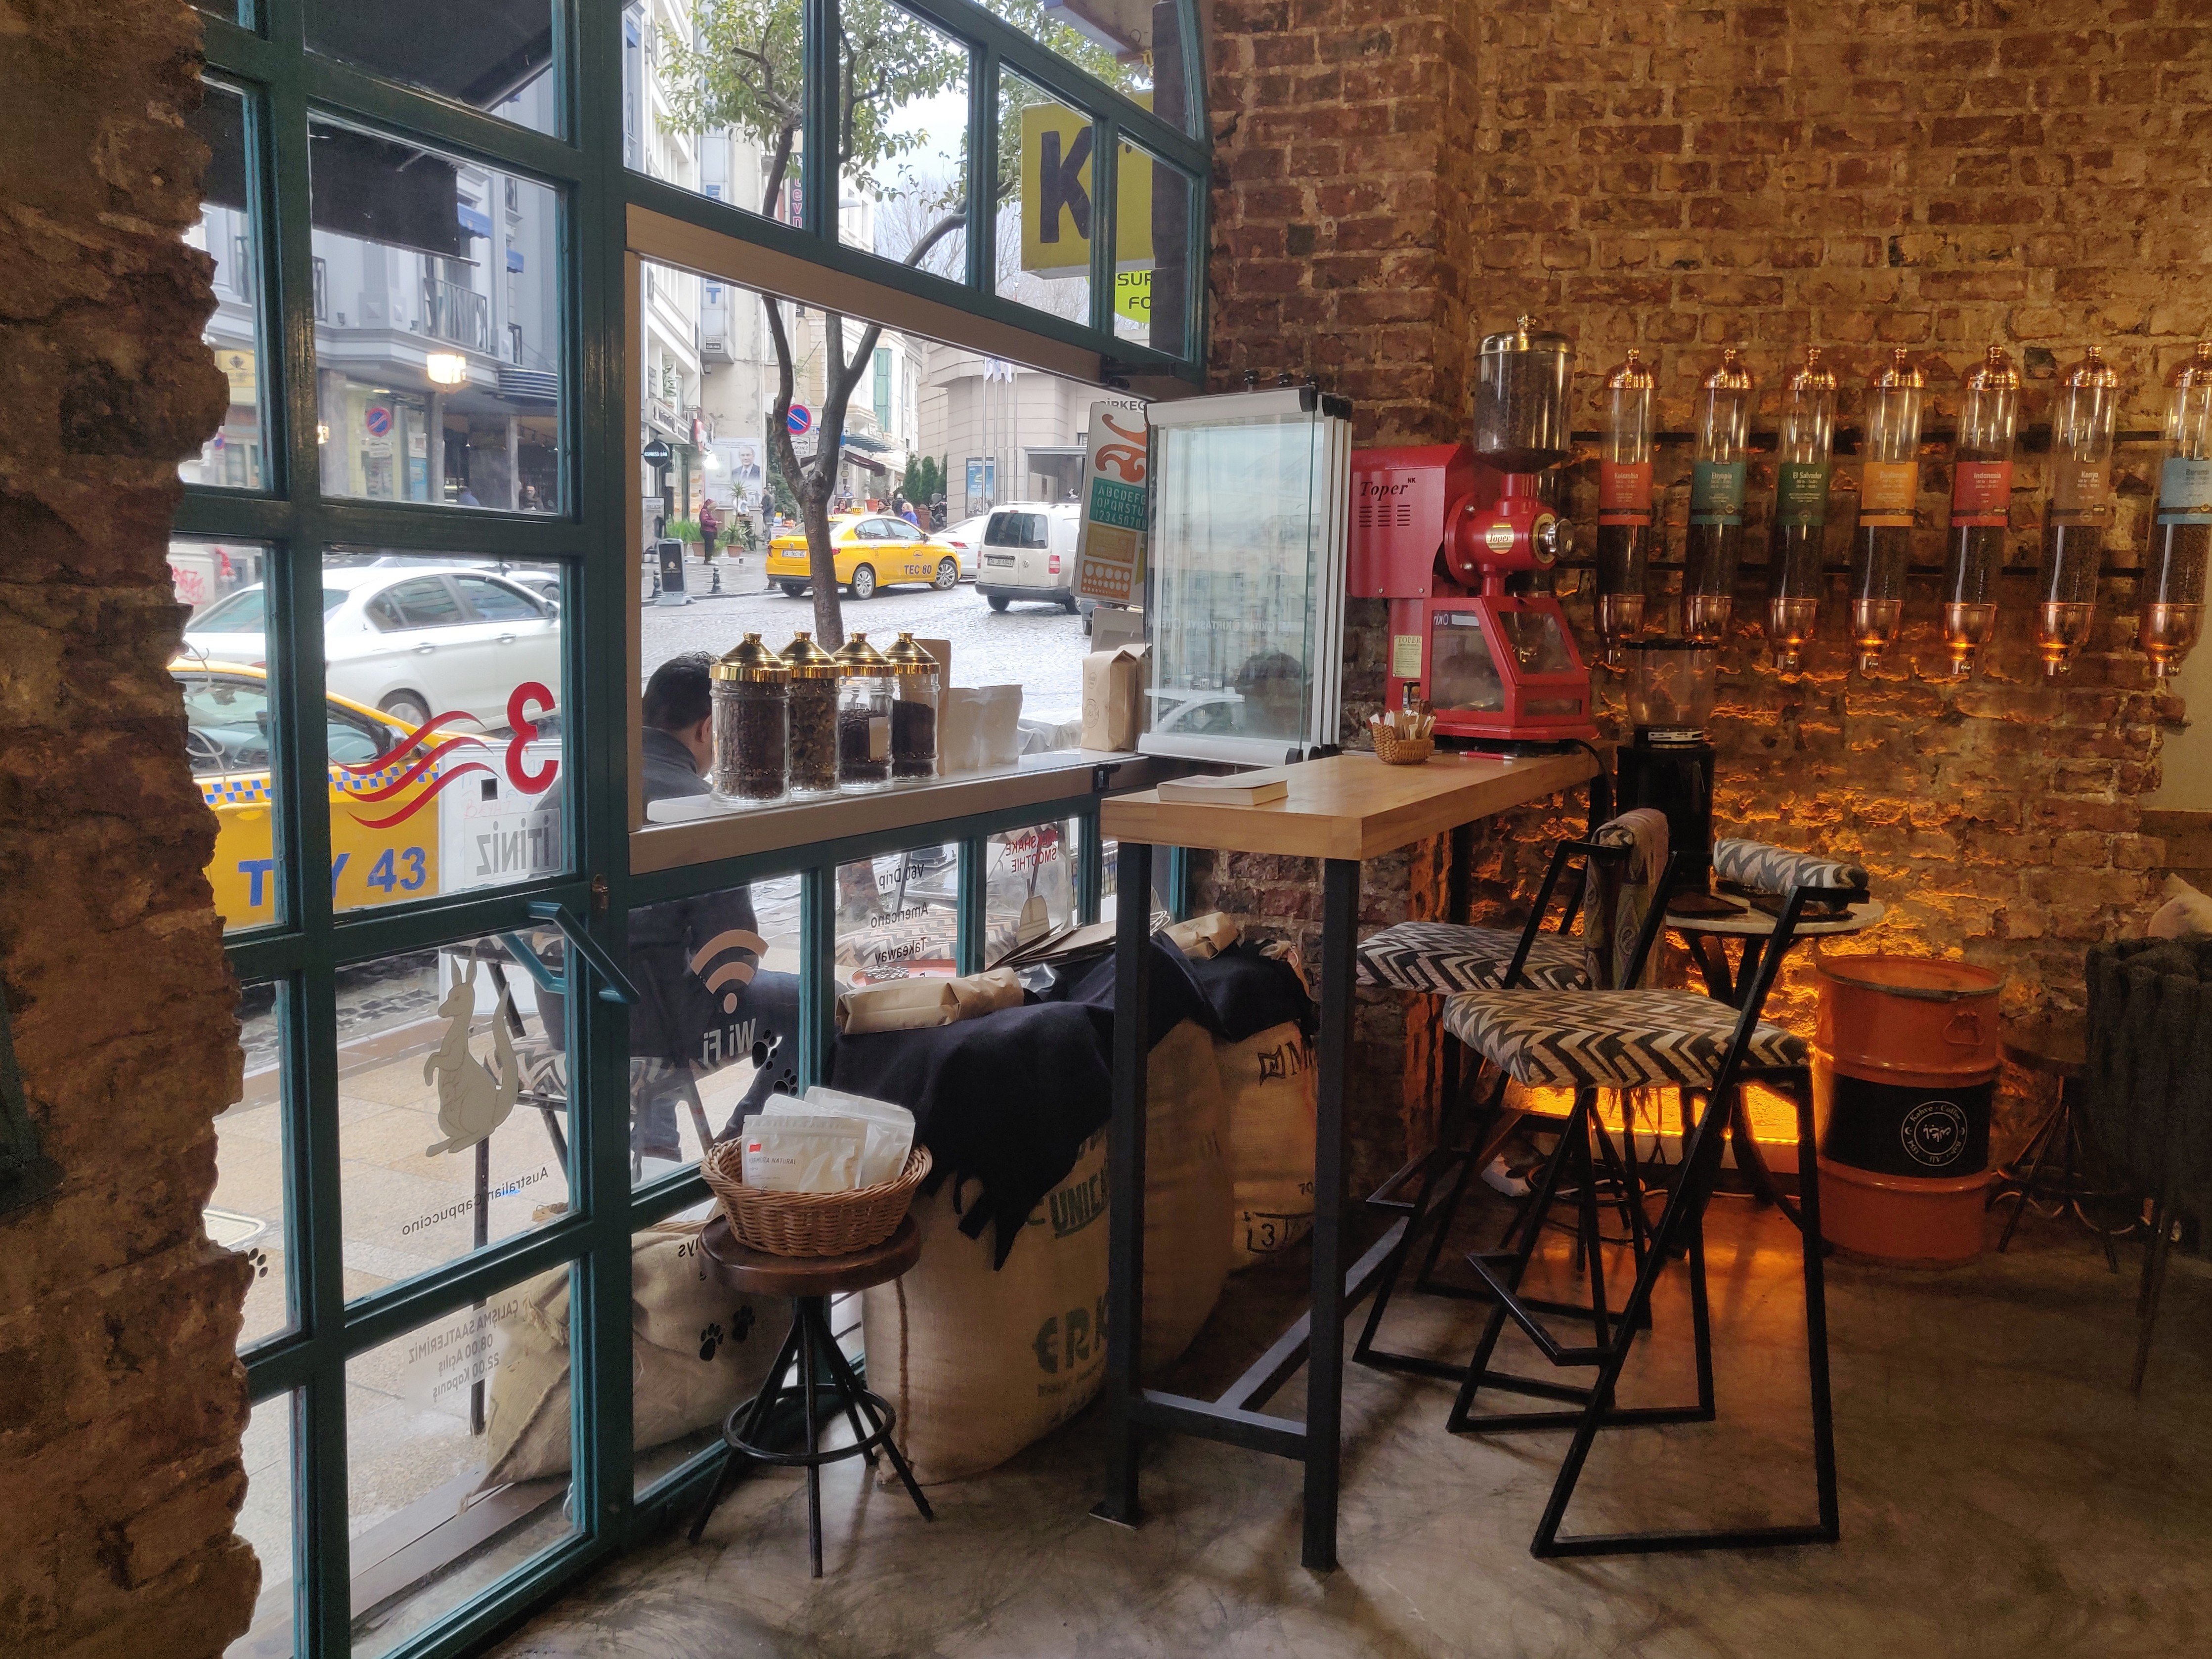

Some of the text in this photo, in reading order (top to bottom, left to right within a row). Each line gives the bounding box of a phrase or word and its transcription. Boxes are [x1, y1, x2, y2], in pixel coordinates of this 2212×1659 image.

[1360, 481, 1408, 501] Toper
[1489, 533, 1511, 544] Toper
[904, 565, 932, 575] TEC 80
[367, 846, 426, 893] 43
[1261, 1222, 1275, 1248] 3
